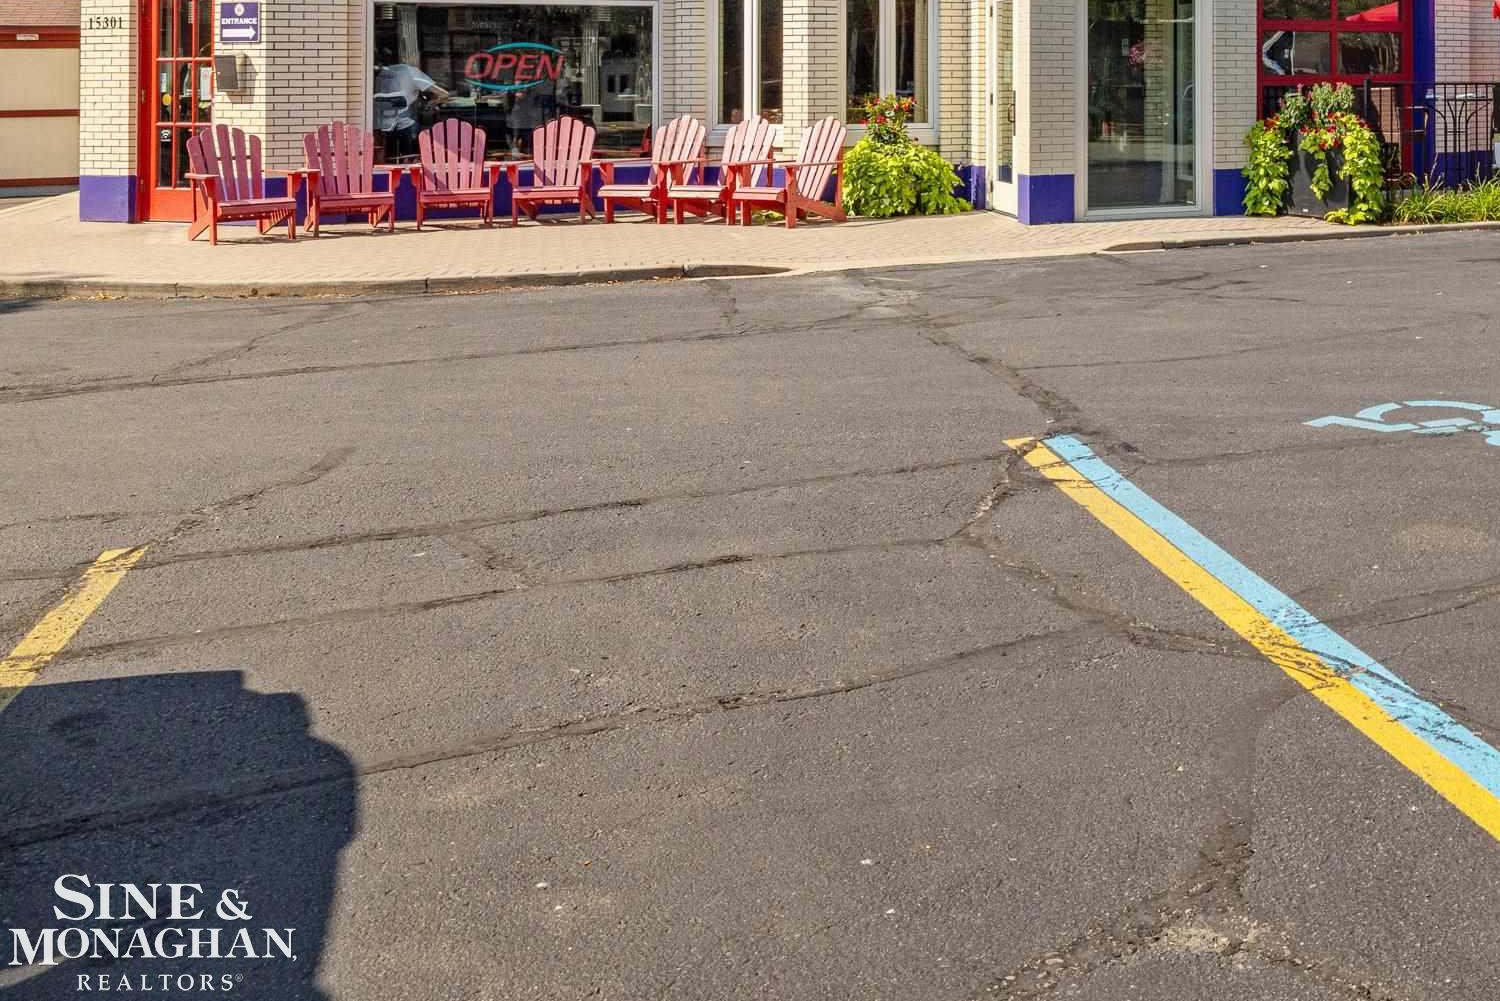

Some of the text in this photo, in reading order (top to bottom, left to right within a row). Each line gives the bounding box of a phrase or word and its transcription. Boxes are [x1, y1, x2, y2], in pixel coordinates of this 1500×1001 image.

[88, 16, 123, 30] 15301
[221, 17, 257, 25] ENTRANCE
[464, 51, 565, 82] OPEN
